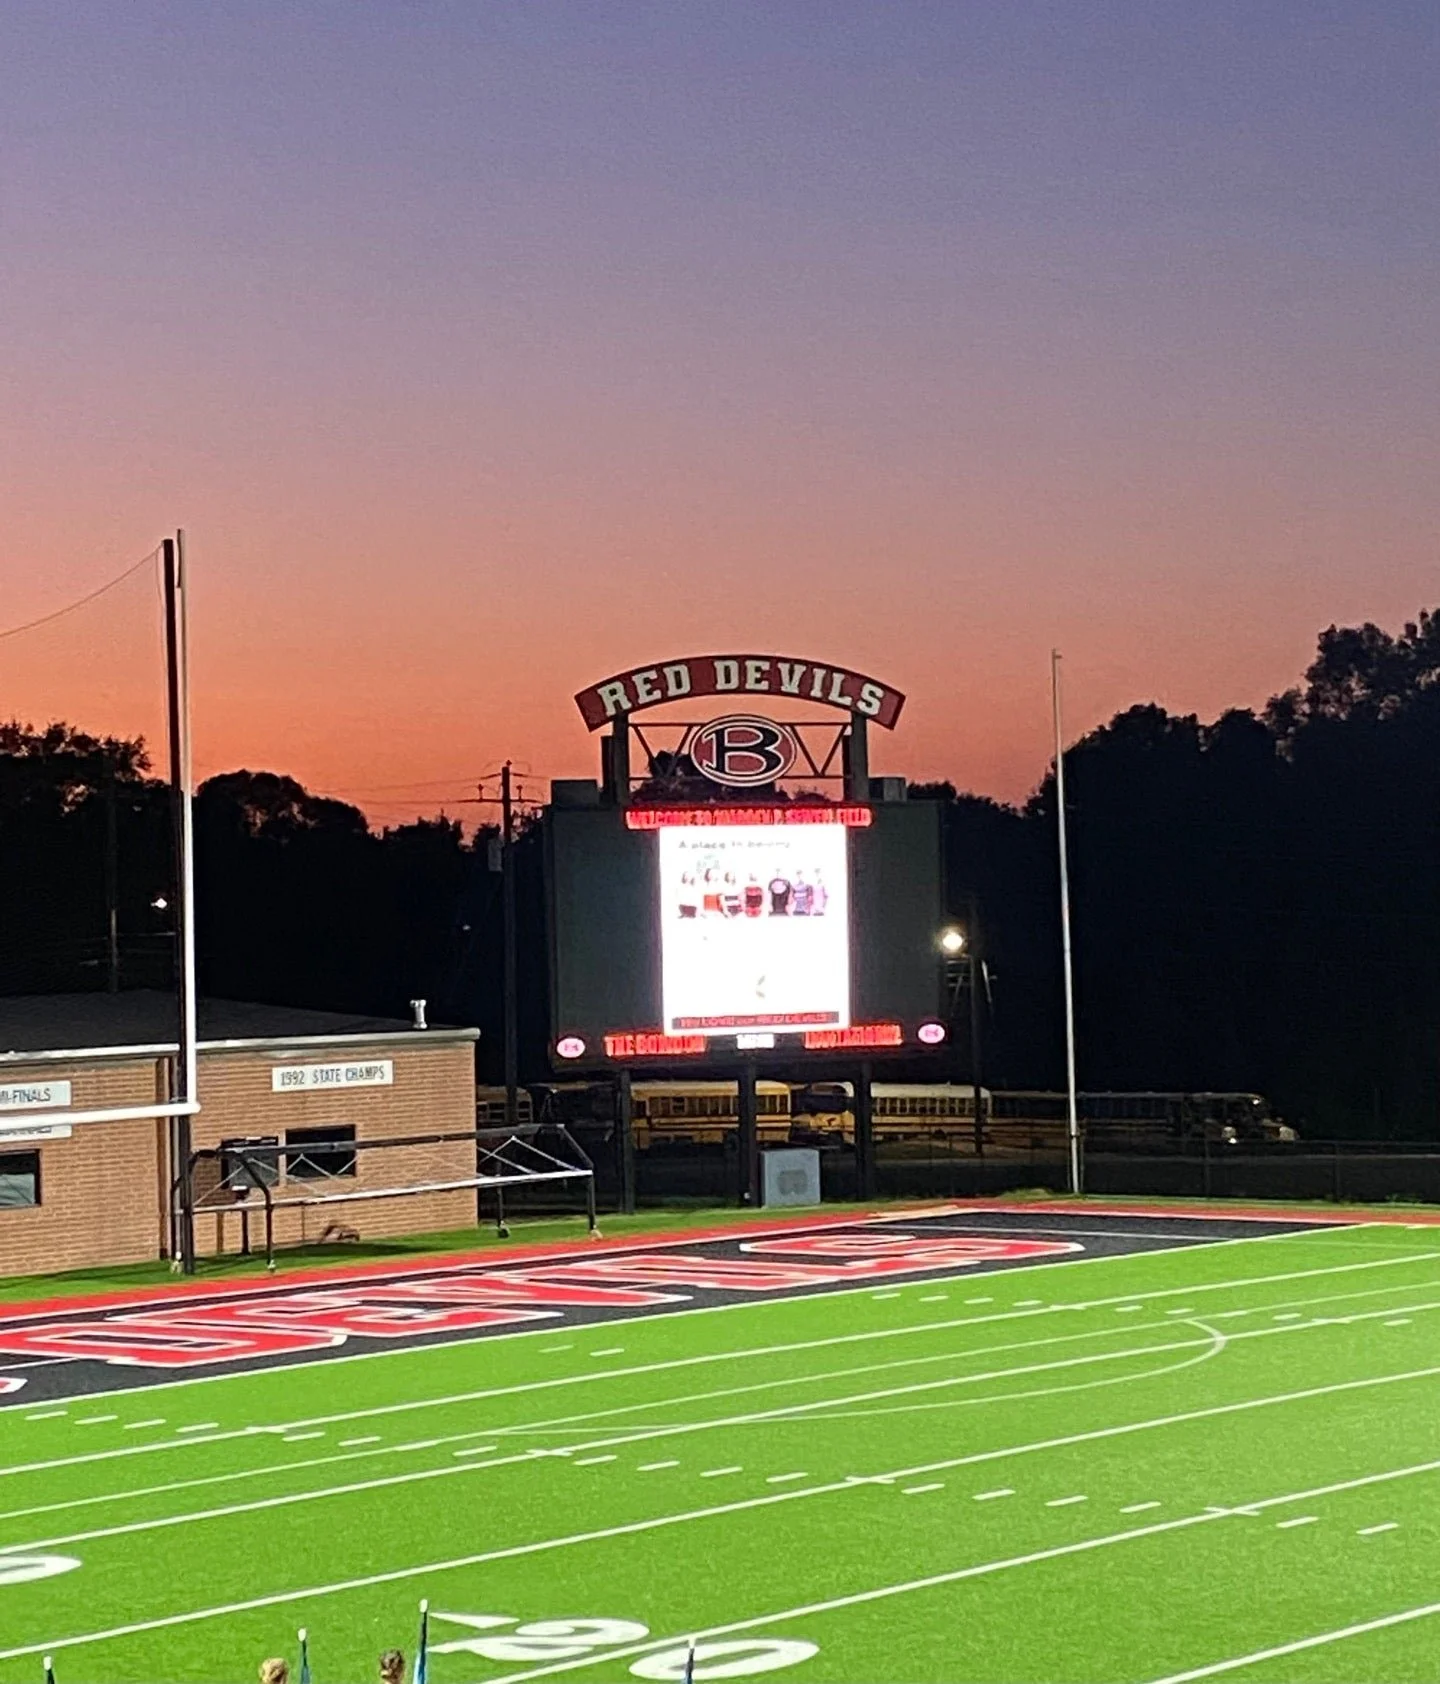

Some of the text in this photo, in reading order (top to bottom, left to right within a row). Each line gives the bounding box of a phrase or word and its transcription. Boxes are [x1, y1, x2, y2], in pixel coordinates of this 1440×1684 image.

[597, 660, 885, 717] RED DEVILS
[702, 725, 785, 776] B
[281, 1065, 385, 1086] 1992 STATE CHAMPS
